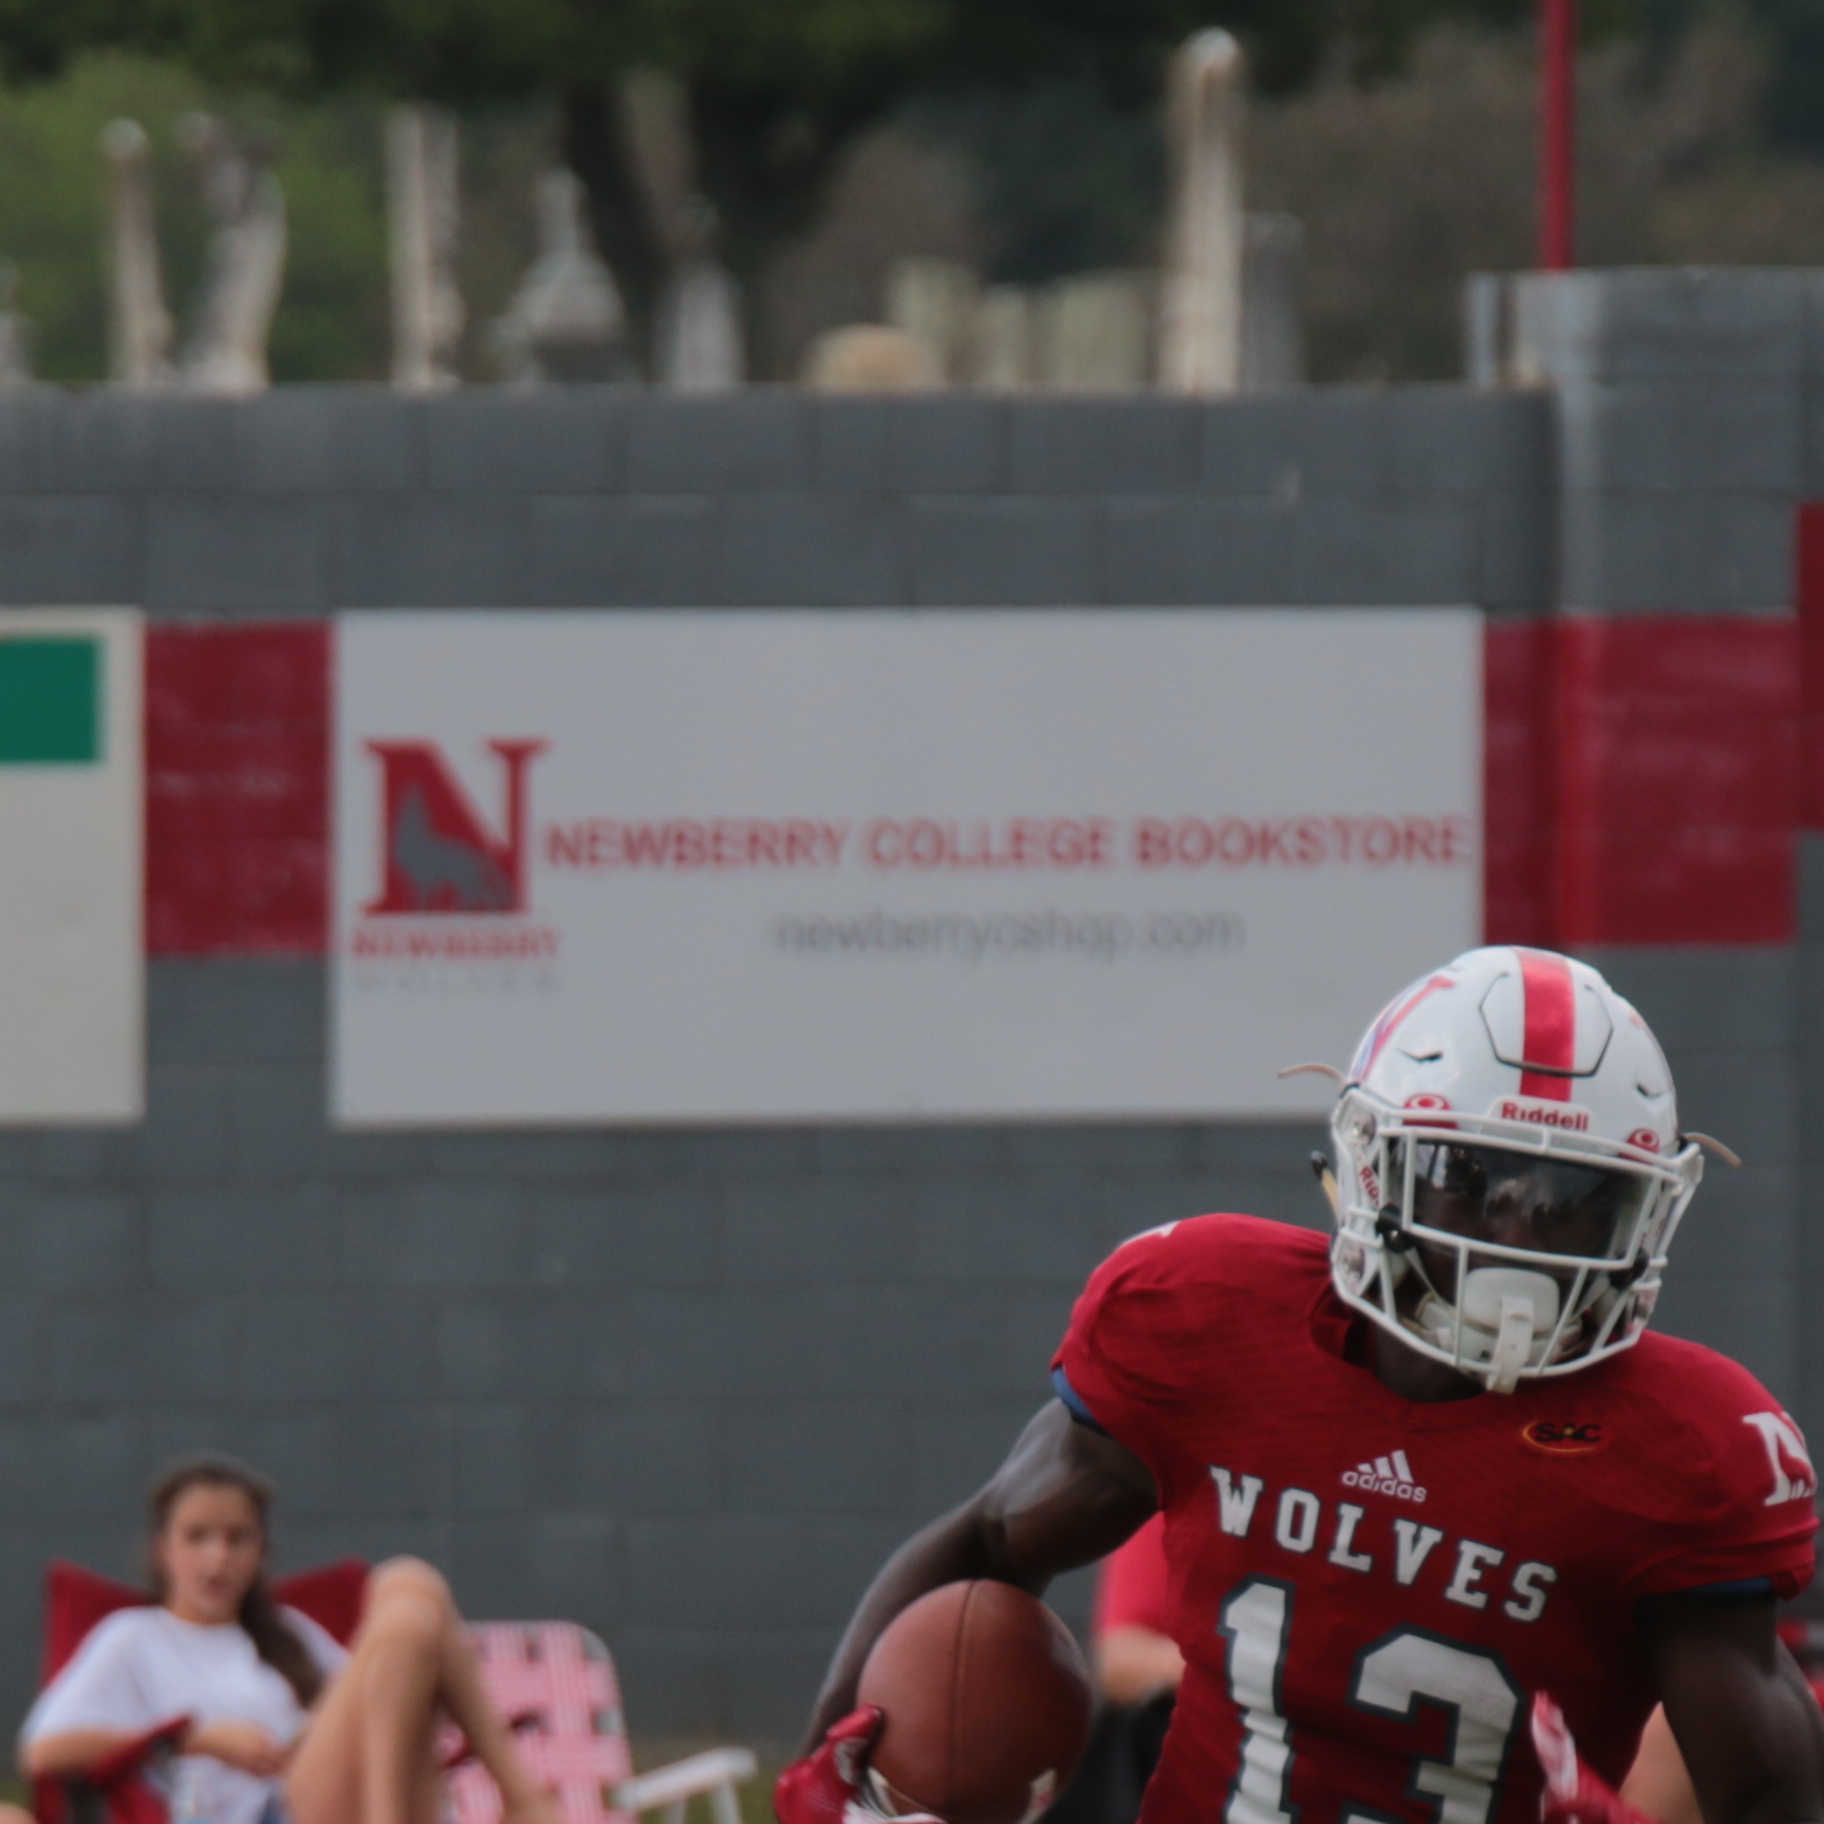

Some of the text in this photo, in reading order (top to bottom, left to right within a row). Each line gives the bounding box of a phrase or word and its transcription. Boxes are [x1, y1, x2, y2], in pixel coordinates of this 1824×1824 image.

[544, 814, 1468, 871] NEWBERRY COLLEGE BOOKSTORE
[1501, 1101, 1589, 1133] Riddell
[1535, 1421, 1603, 1443] SAC
[1341, 1468, 1428, 1503] adidas
[1207, 1464, 1560, 1623] WOLVES
